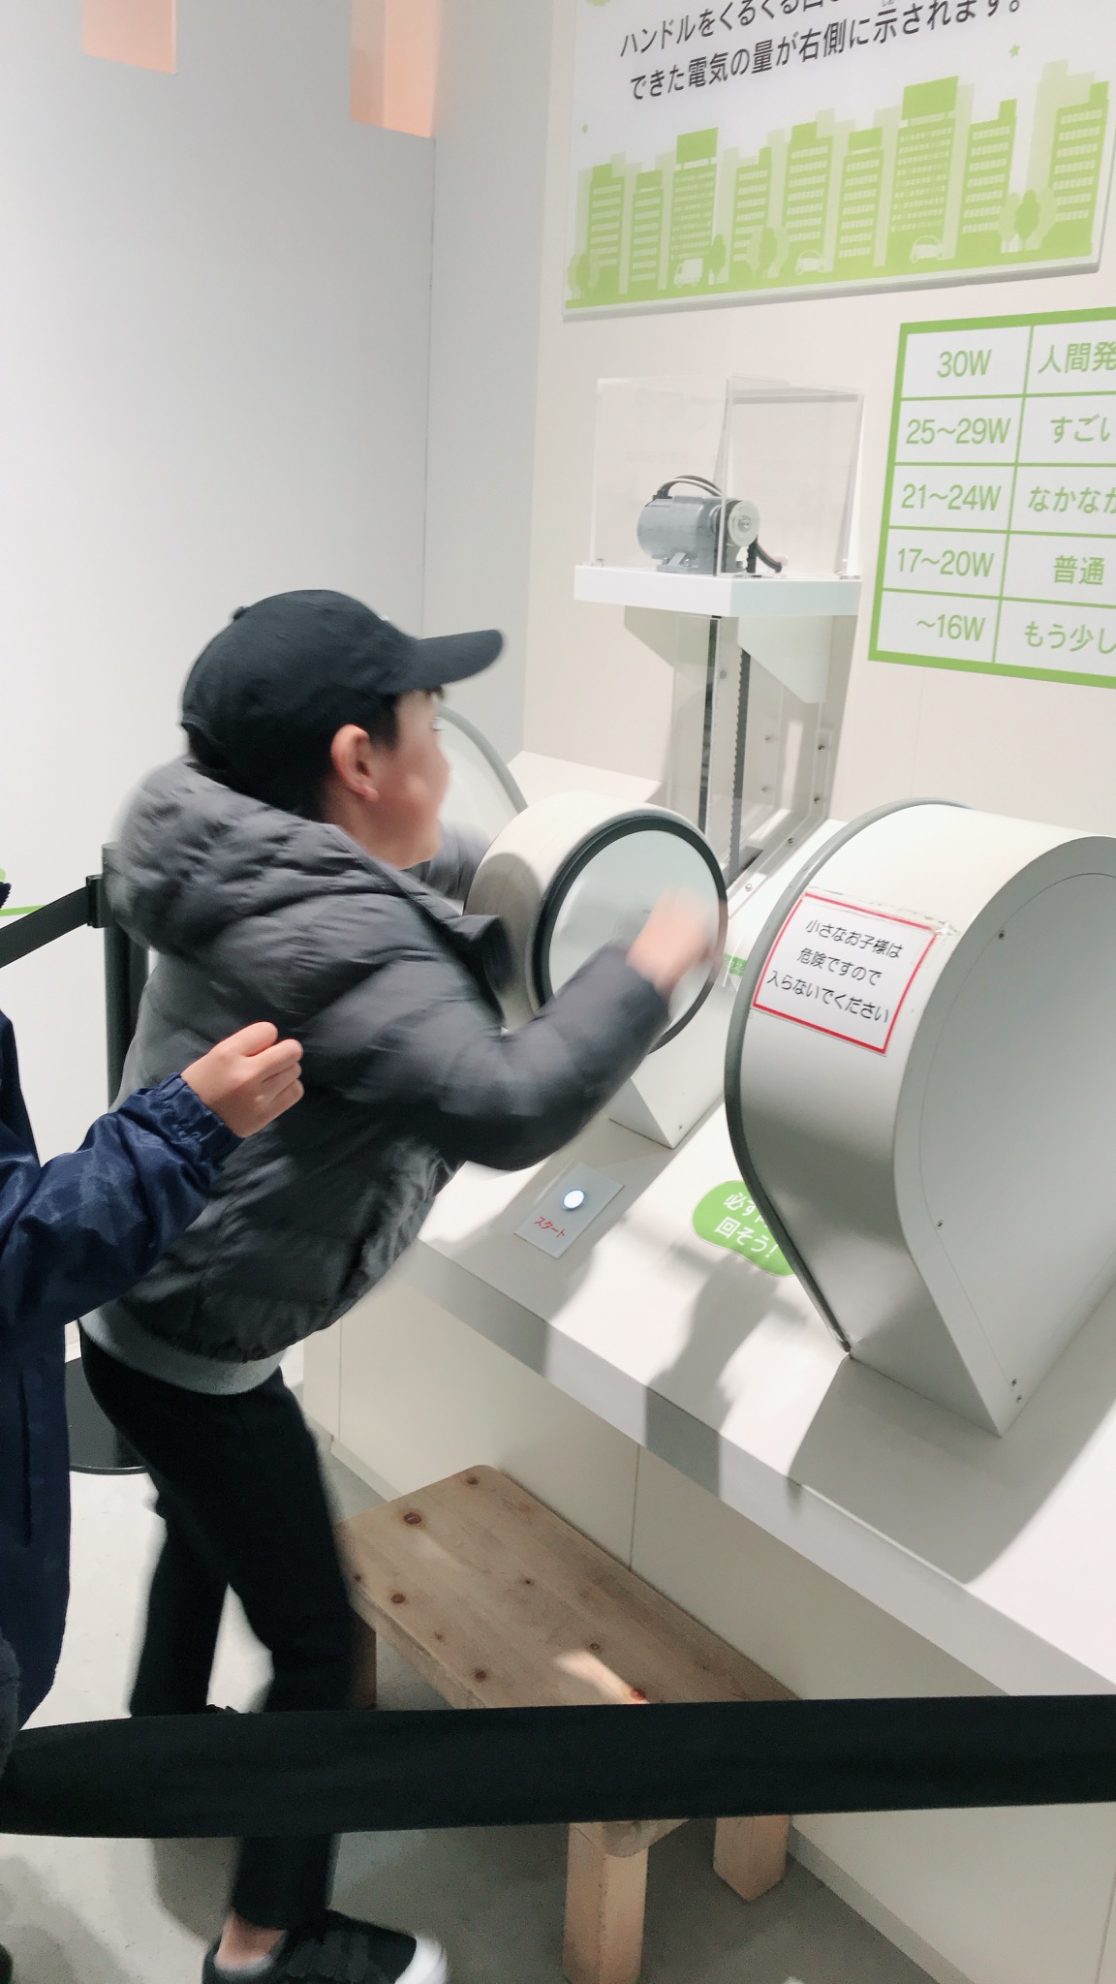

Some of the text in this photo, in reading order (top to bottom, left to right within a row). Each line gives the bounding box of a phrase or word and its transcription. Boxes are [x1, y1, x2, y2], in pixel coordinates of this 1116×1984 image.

[620, 0, 839, 57] ハンドルをくるくる
[937, 350, 991, 378] 30W
[1054, 555, 1105, 586] 普通
[1024, 621, 1116, 654] もう少し
[806, 919, 903, 959] 小さなお子様は
[797, 947, 883, 986] 危険ですので
[767, 970, 889, 1023] 入らないでください
[534, 1216, 566, 1238] スタート
